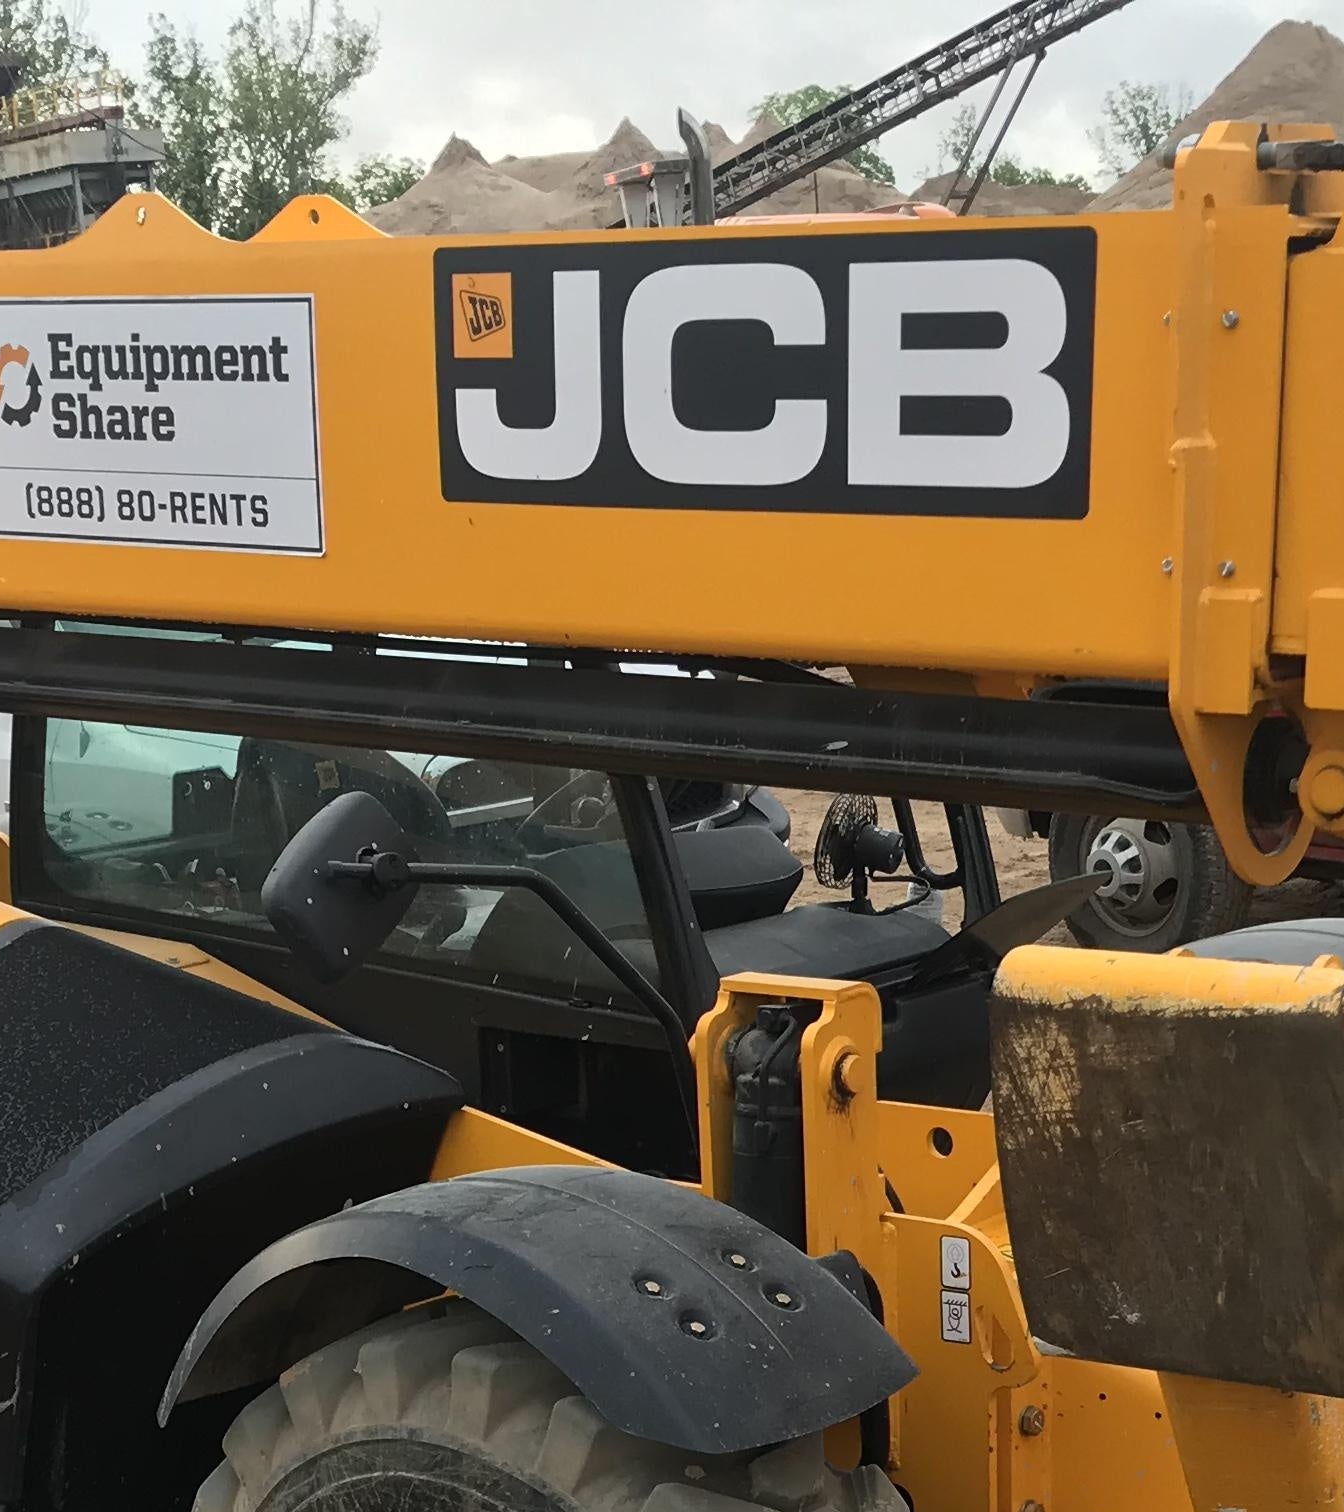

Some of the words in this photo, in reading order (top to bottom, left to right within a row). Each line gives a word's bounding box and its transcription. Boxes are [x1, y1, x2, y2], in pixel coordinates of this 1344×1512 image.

[468, 296, 503, 336] JCB
[47, 333, 290, 393] Equipment
[456, 259, 1070, 489] JCB
[52, 393, 176, 441] Share
[25, 482, 106, 522] (888)
[116, 489, 270, 528] 80-RENTS
